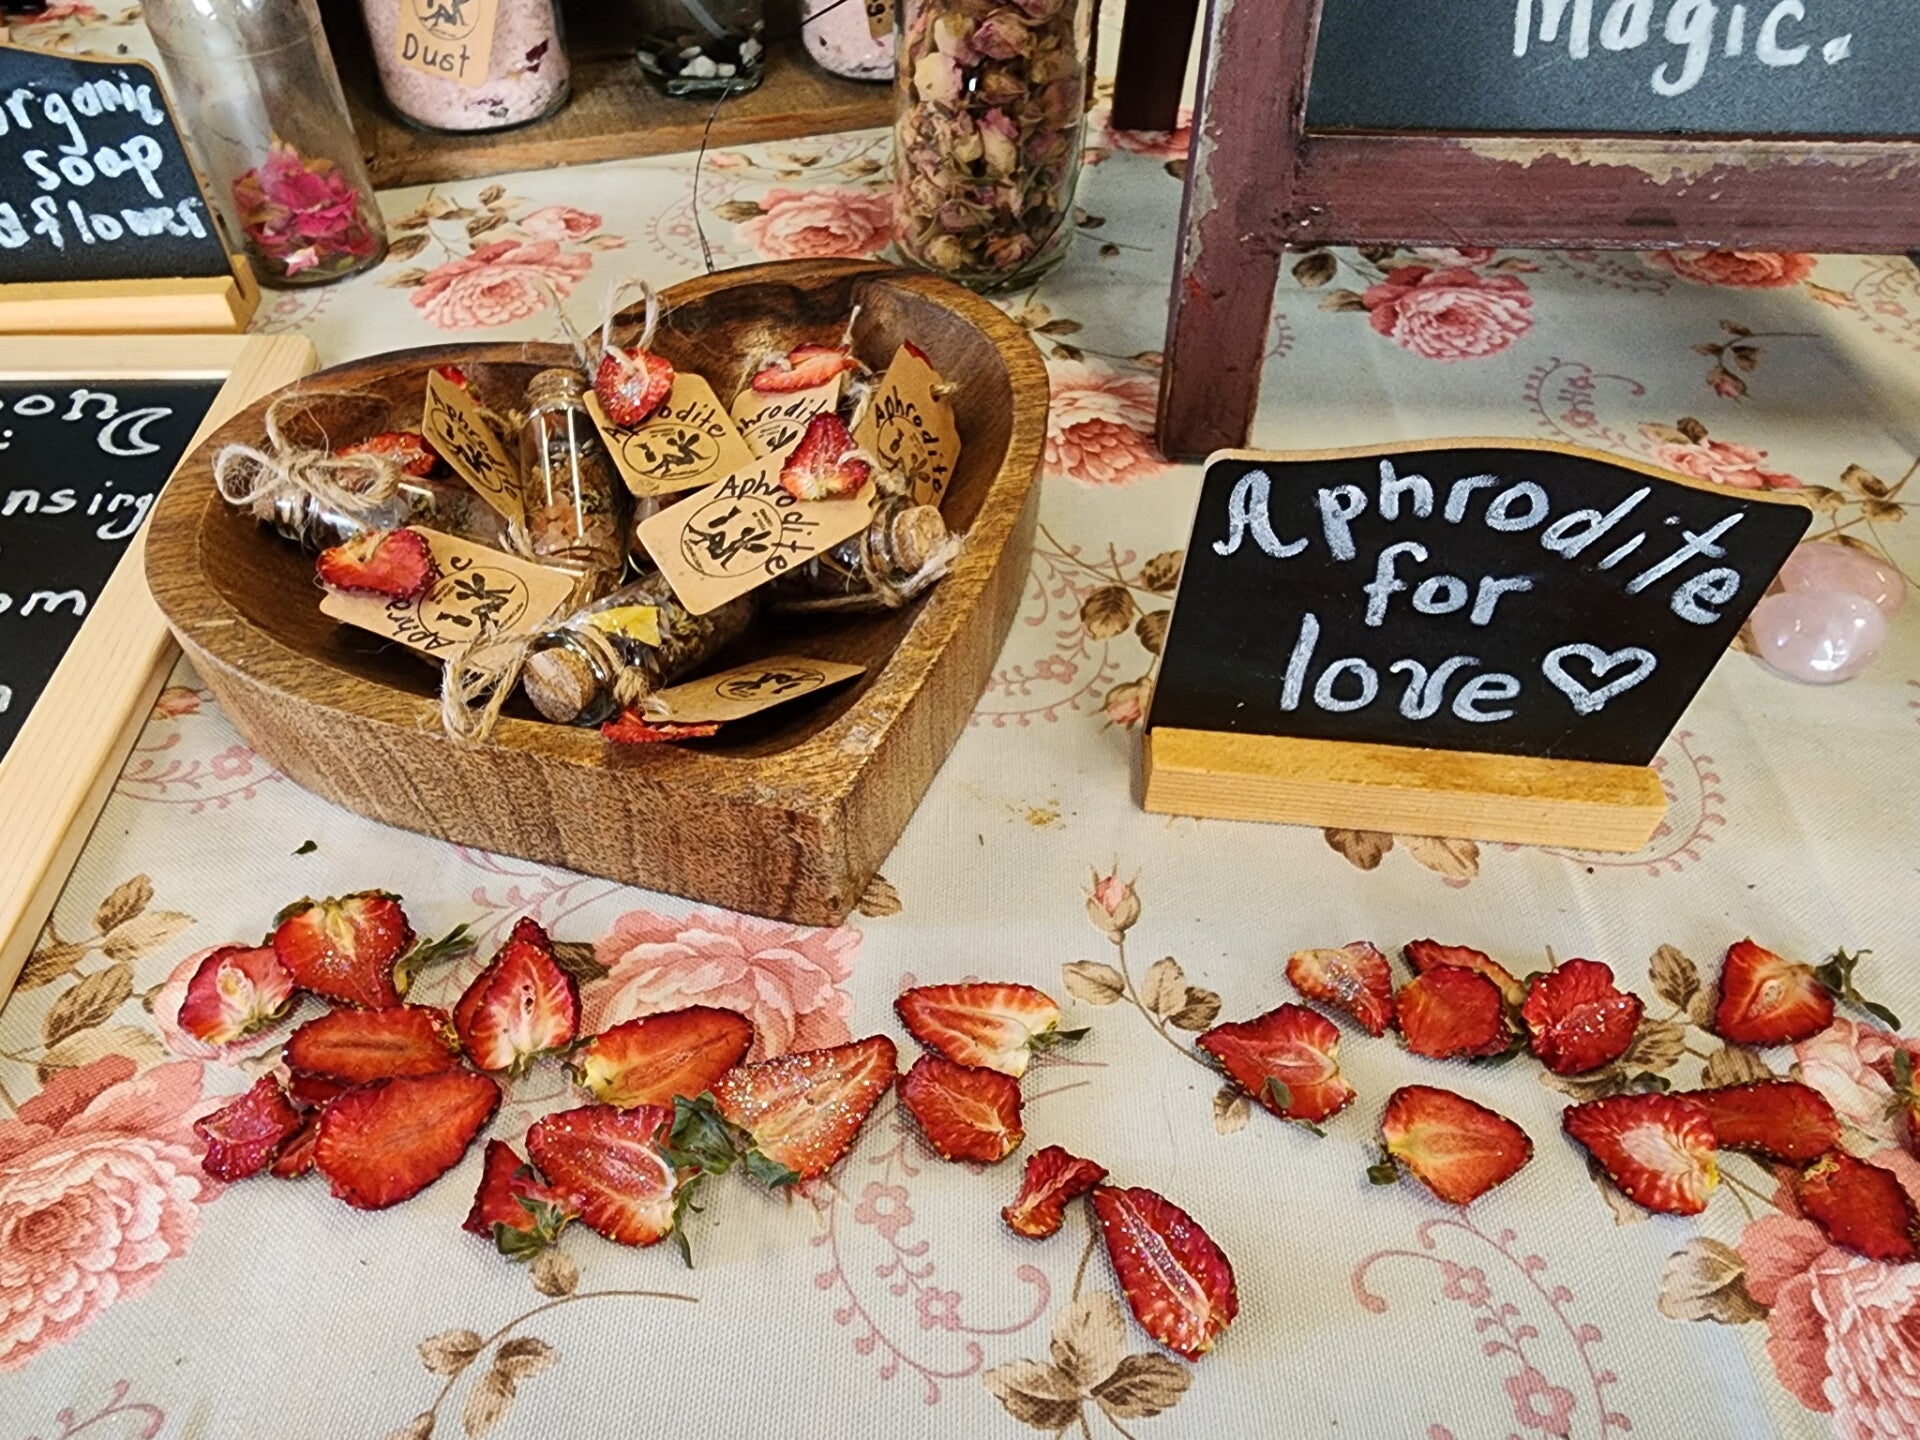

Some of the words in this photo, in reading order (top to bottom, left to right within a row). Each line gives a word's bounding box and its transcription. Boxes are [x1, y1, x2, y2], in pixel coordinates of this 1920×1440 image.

[402, 33, 470, 78] Dust
[22, 134, 164, 199] soap
[1212, 459, 1744, 625] Aphrodite
[1363, 541, 1534, 627] for
[1279, 612, 1523, 723] love
